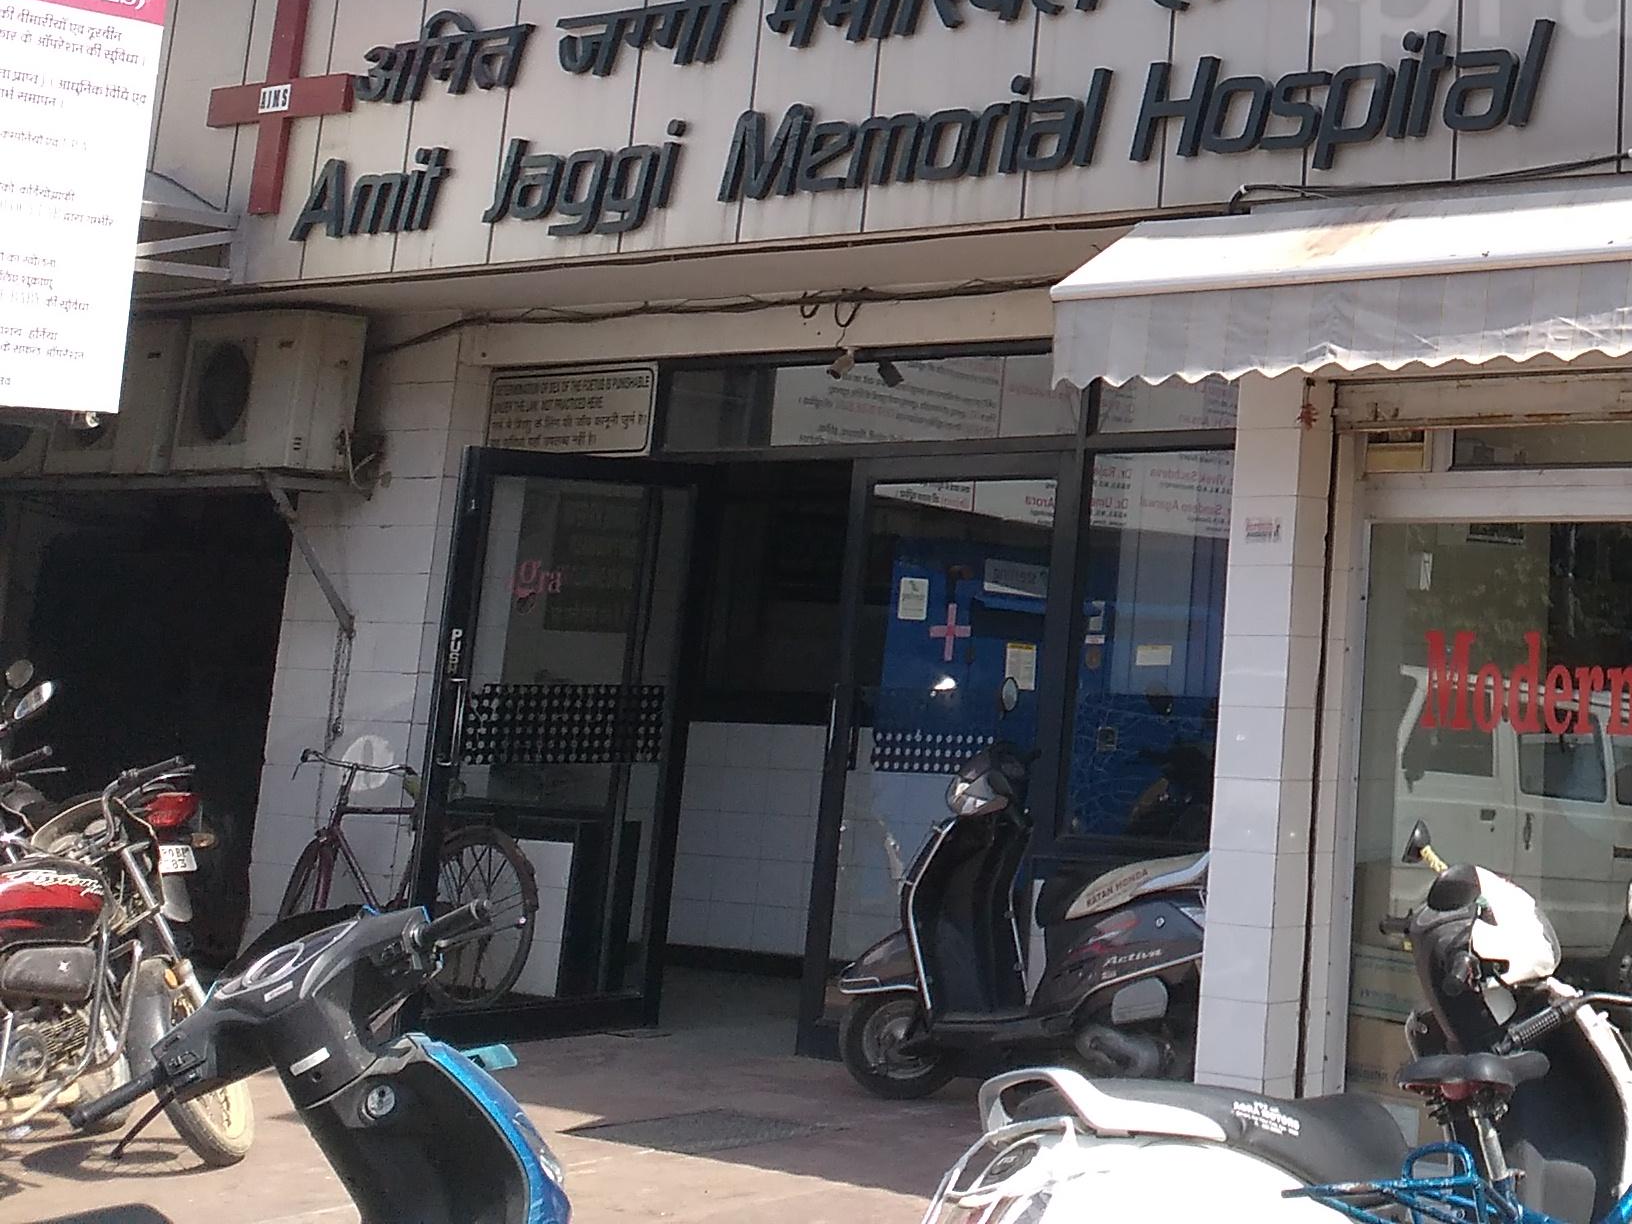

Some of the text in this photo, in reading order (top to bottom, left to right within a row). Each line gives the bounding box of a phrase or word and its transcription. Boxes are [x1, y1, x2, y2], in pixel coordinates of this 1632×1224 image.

[353, 9, 537, 106] अमित
[289, 16, 1558, 243] Amit Jaggi Memorial Hospital
[1102, 948, 1163, 968] Activa
